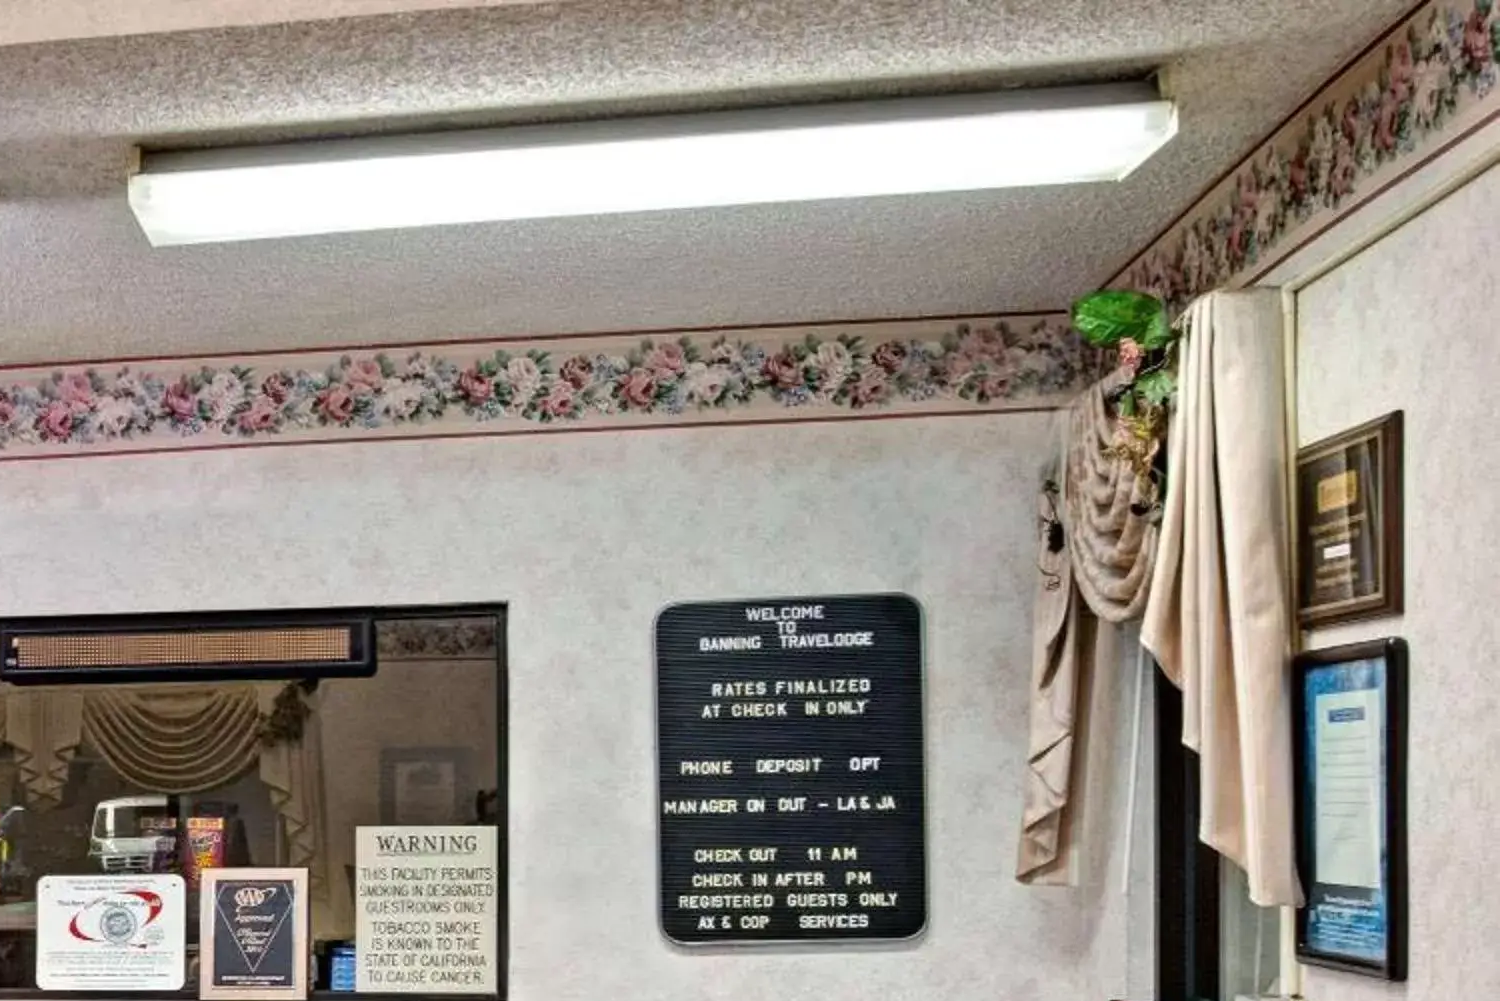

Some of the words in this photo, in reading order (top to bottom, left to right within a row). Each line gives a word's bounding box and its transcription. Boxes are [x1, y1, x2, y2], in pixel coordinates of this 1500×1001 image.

[746, 606, 824, 621] WELCOME
[777, 621, 797, 634] TO
[700, 635, 762, 651] BANNING
[780, 632, 874, 648] TRAVELODGE
[711, 682, 766, 697] RATES
[776, 679, 871, 694] FINALIZED
[702, 704, 720, 718] AT
[731, 703, 787, 717] CHECK
[805, 701, 820, 715] IN
[826, 700, 869, 715] ONLY
[681, 761, 733, 775] PHONE
[756, 758, 822, 773] DEPOSIT
[850, 757, 881, 771] OPT
[664, 799, 738, 814] MANAGER
[747, 799, 765, 813] ON
[876, 796, 896, 810] JA
[376, 835, 478, 853] WARNING
[694, 849, 743, 863] CHECK
[749, 848, 778, 862] OUT
[807, 848, 821, 861] 11
[831, 847, 857, 861] AM
[361, 867, 388, 881] THIS
[391, 867, 437, 880] FACILITY
[441, 867, 493, 880] PERMITS
[692, 873, 744, 888] CHECK
[752, 873, 768, 887] IN
[775, 872, 825, 887] AFTER
[845, 871, 872, 886] PM
[360, 884, 409, 897] SMOKING
[412, 884, 424, 897] IN
[427, 884, 494, 897] DESIGNATED
[365, 901, 451, 914] GUESTROOMS
[678, 894, 774, 909] REGISTERED
[787, 893, 848, 908] GUESTS
[859, 893, 898, 907] ONLY
[371, 922, 431, 934] TOBACCO
[435, 921, 481, 935] SMOKE
[697, 916, 715, 930] AX
[799, 914, 869, 929] SERVICES
[371, 938, 384, 951] IS
[387, 938, 433, 950] KNOWN
[436, 938, 452, 950] TO
[456, 937, 480, 950] THE
[365, 954, 399, 967] STATE
[402, 954, 417, 967] OF
[420, 953, 487, 967] CALIFORNIA
[368, 970, 383, 984] TO
[386, 970, 427, 984] CAUSE
